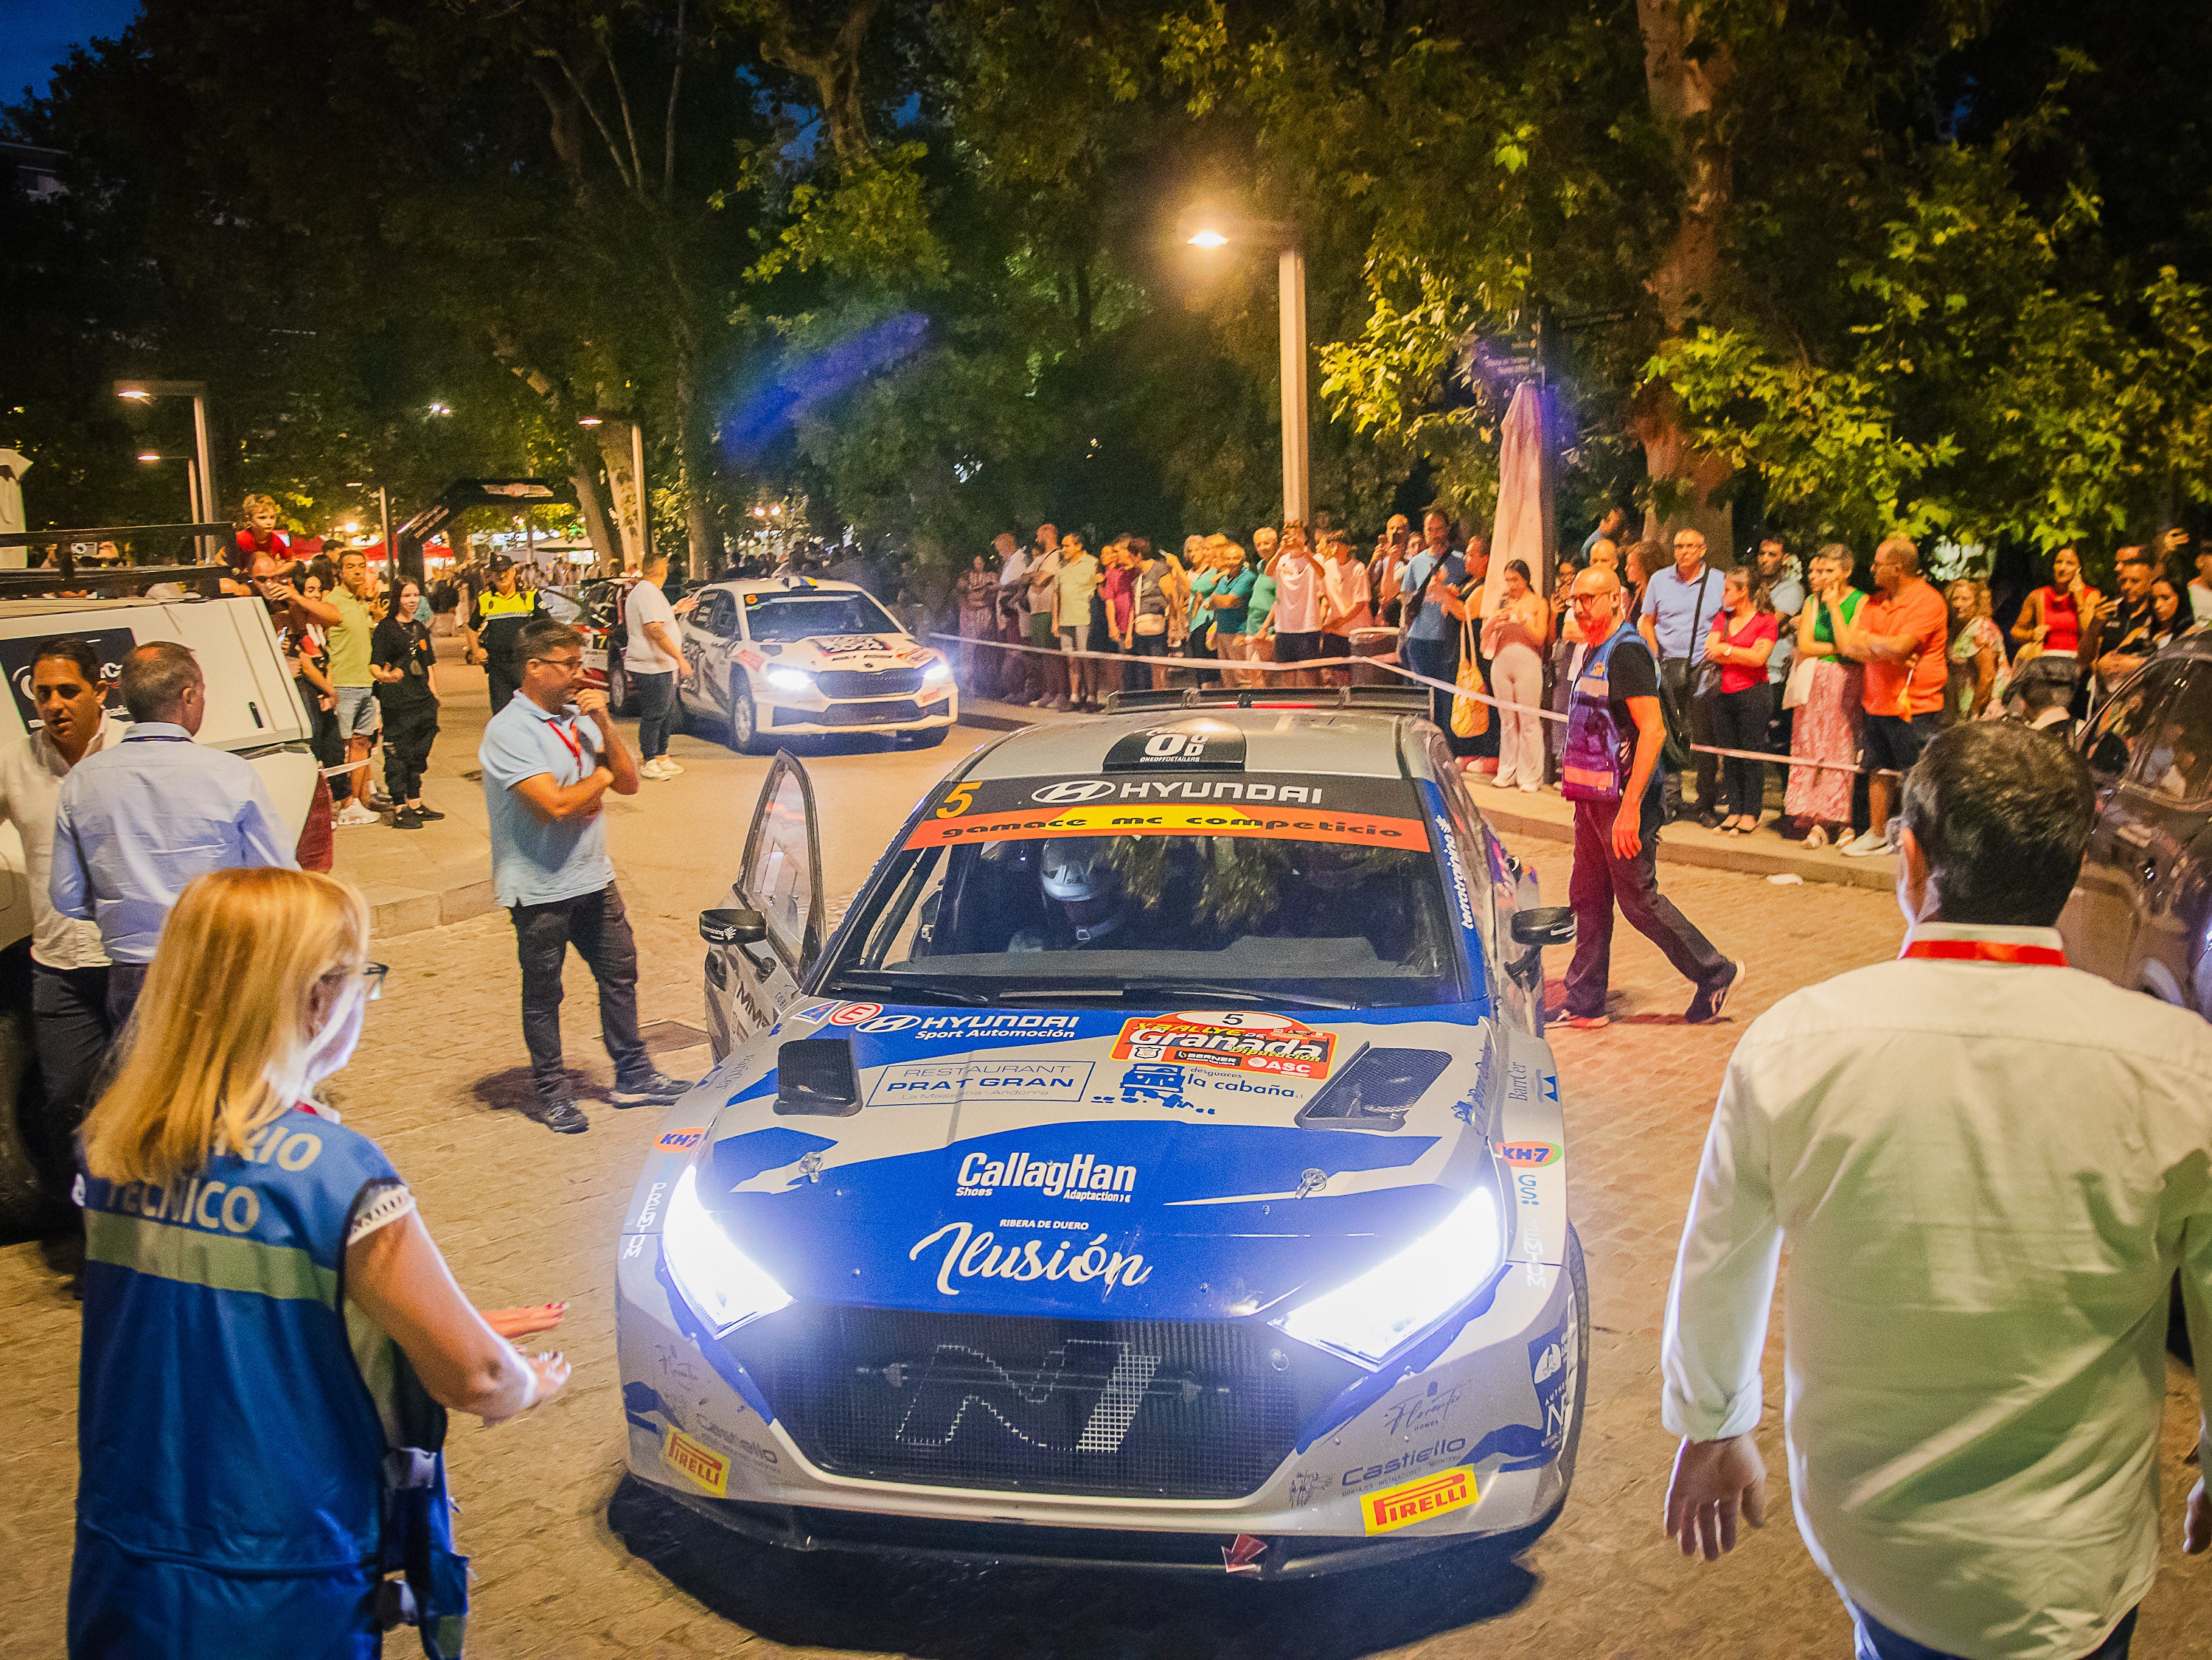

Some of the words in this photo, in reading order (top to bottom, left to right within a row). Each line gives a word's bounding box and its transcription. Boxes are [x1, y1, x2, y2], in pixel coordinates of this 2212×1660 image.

[597, 635, 608, 649] 7
[936, 781, 982, 819] 5
[1119, 781, 1323, 804] HYUNDAI
[942, 819, 1088, 838] gamace
[1111, 817, 1163, 826] mc
[1186, 817, 1402, 837] competicio
[841, 1006, 872, 1021] E
[920, 1016, 1081, 1029] HYUNDAI
[1222, 1014, 1244, 1025] 5
[914, 1030, 966, 1039] Sport
[969, 1030, 1075, 1038] Automoción
[1129, 1028, 1323, 1059] Granada
[1186, 1053, 1237, 1063] BERNER
[1229, 1045, 1321, 1062] Diputación
[903, 1065, 1071, 1077] RESTAURANT
[1191, 1067, 1242, 1078] desguaces
[1265, 1060, 1311, 1073] ASC
[886, 1078, 971, 1092] PRAT
[978, 1078, 1074, 1087] GRAN
[1188, 1074, 1207, 1088] la
[1214, 1080, 1295, 1098] cabaña
[956, 1187, 992, 1196] Shoes
[999, 1219, 1035, 1229] RIBERA
[1037, 1220, 1051, 1229] DE
[1053, 1221, 1089, 1230] DUERO
[668, 1432, 723, 1486] PIRELLI
[1342, 1438, 1466, 1486] Castiello
[1373, 1473, 1467, 1526] PIRELLI
